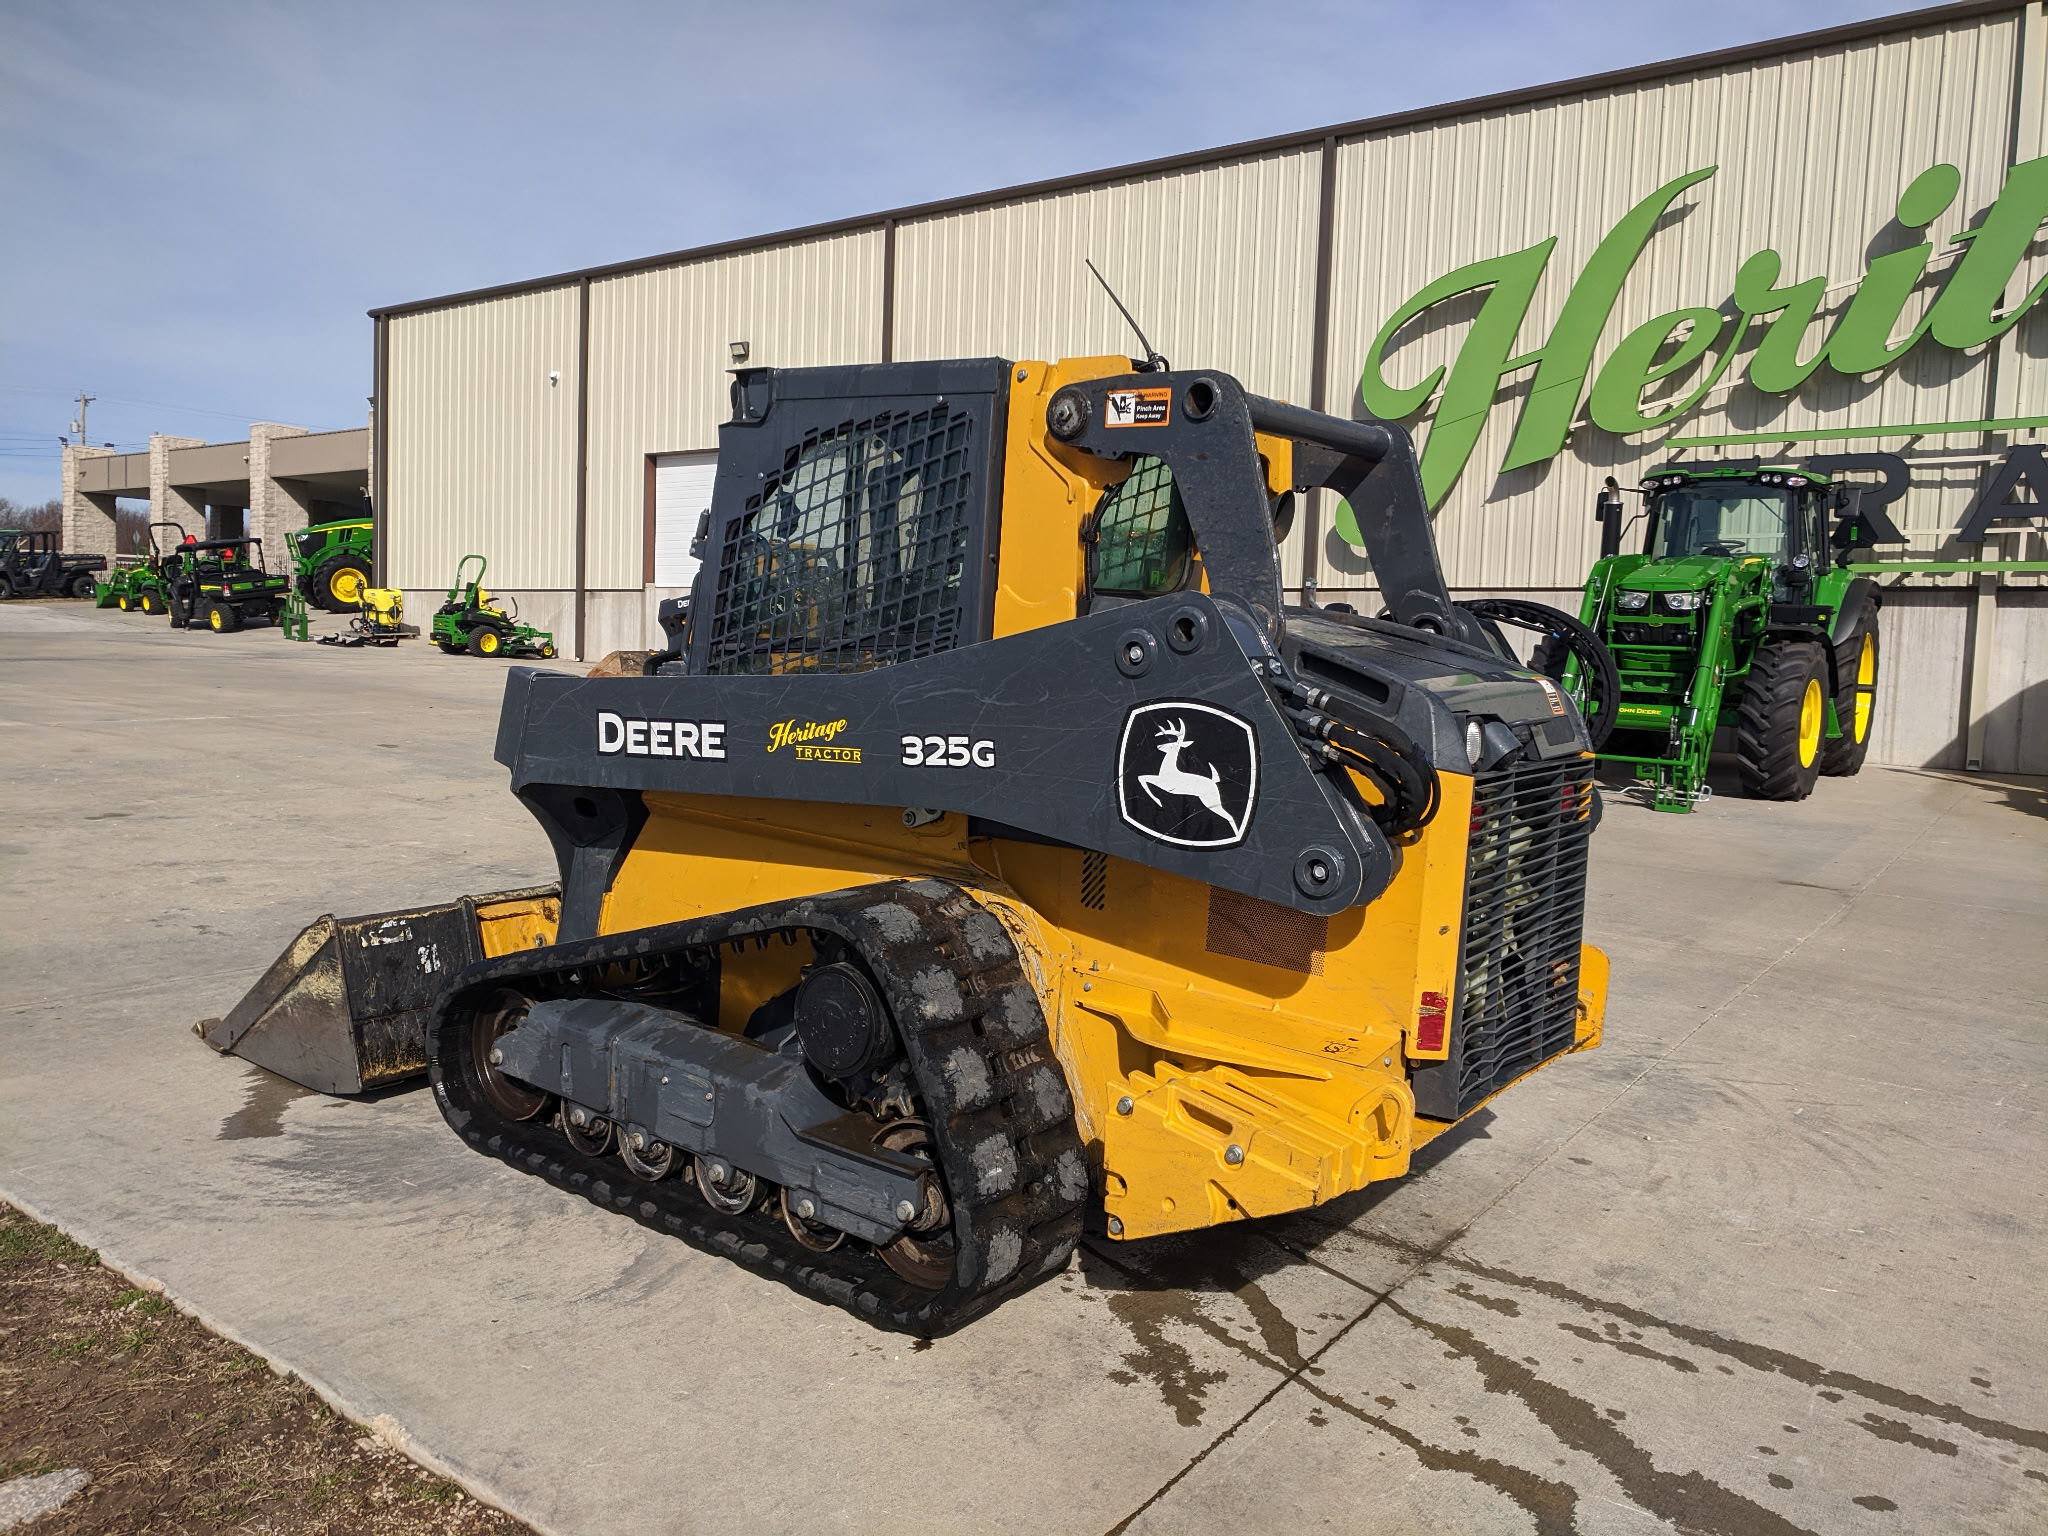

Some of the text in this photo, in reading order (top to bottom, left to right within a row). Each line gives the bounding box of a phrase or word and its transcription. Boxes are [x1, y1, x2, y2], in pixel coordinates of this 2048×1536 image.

[1136, 404, 1152, 412] Pinch
[1135, 412, 1161, 420] Keep Away
[677, 599, 690, 609] DE
[598, 712, 725, 758] DEERE
[767, 719, 847, 752] Heritage
[796, 747, 861, 761] TRACTOR
[901, 736, 995, 768] 325G
